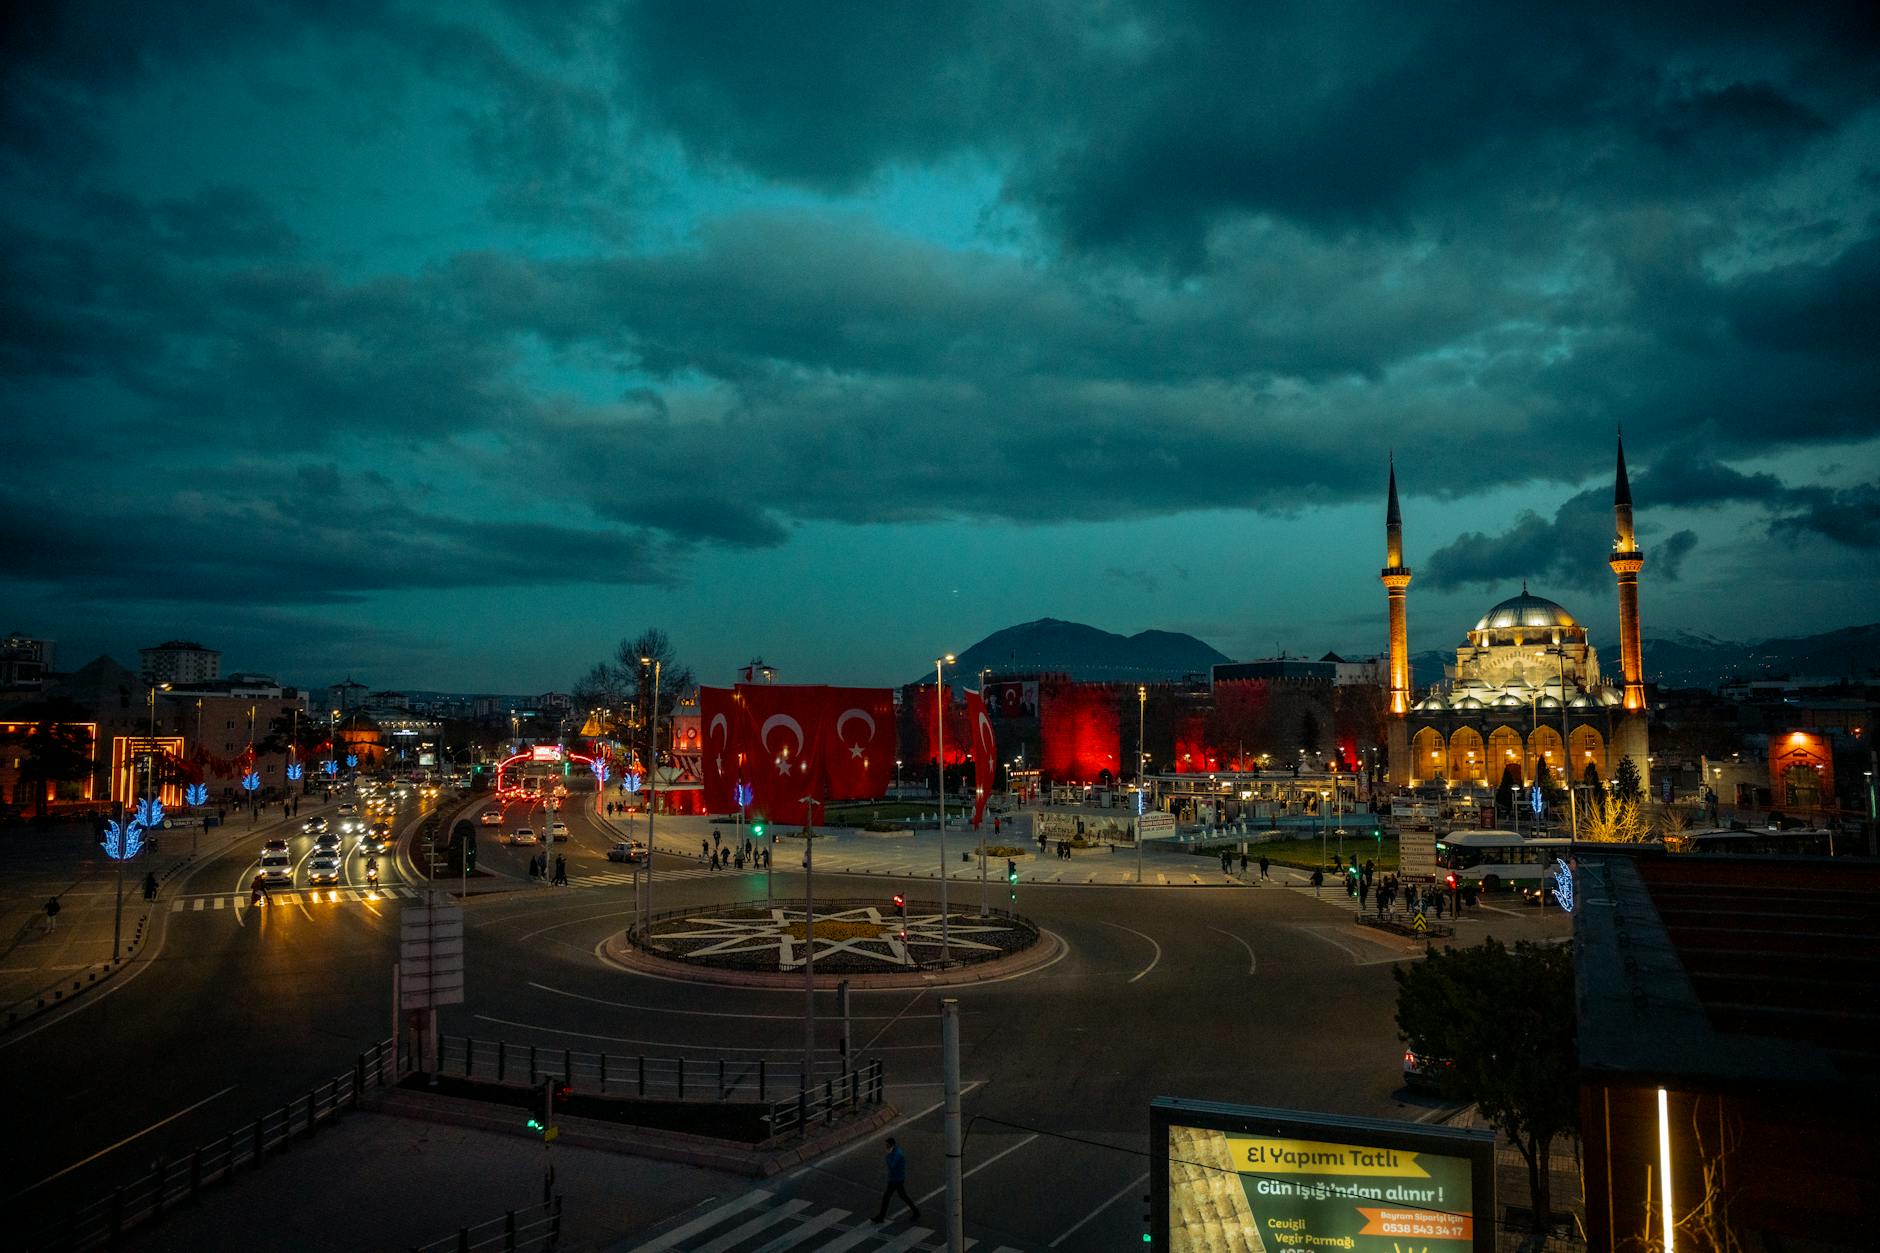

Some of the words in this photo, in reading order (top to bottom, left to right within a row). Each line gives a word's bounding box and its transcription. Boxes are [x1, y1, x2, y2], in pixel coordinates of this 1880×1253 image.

[1247, 1147, 1265, 1162] El
[1270, 1148, 1345, 1168] Yapımı
[1352, 1150, 1398, 1167] Tatlı
[1257, 1180, 1292, 1195] Gün
[1386, 1186, 1435, 1201] alınır
[1267, 1218, 1306, 1231] Cevizli
[1380, 1211, 1413, 1222] Bayram
[1414, 1212, 1446, 1223] Siparişi
[1447, 1213, 1464, 1224] için
[1382, 1223, 1411, 1233] 0538
[1413, 1224, 1433, 1234] 543
[1435, 1225, 1450, 1235] 34
[1451, 1226, 1464, 1236] 17
[1274, 1232, 1303, 1245] Vezir
[1305, 1234, 1355, 1249] Parmağı
